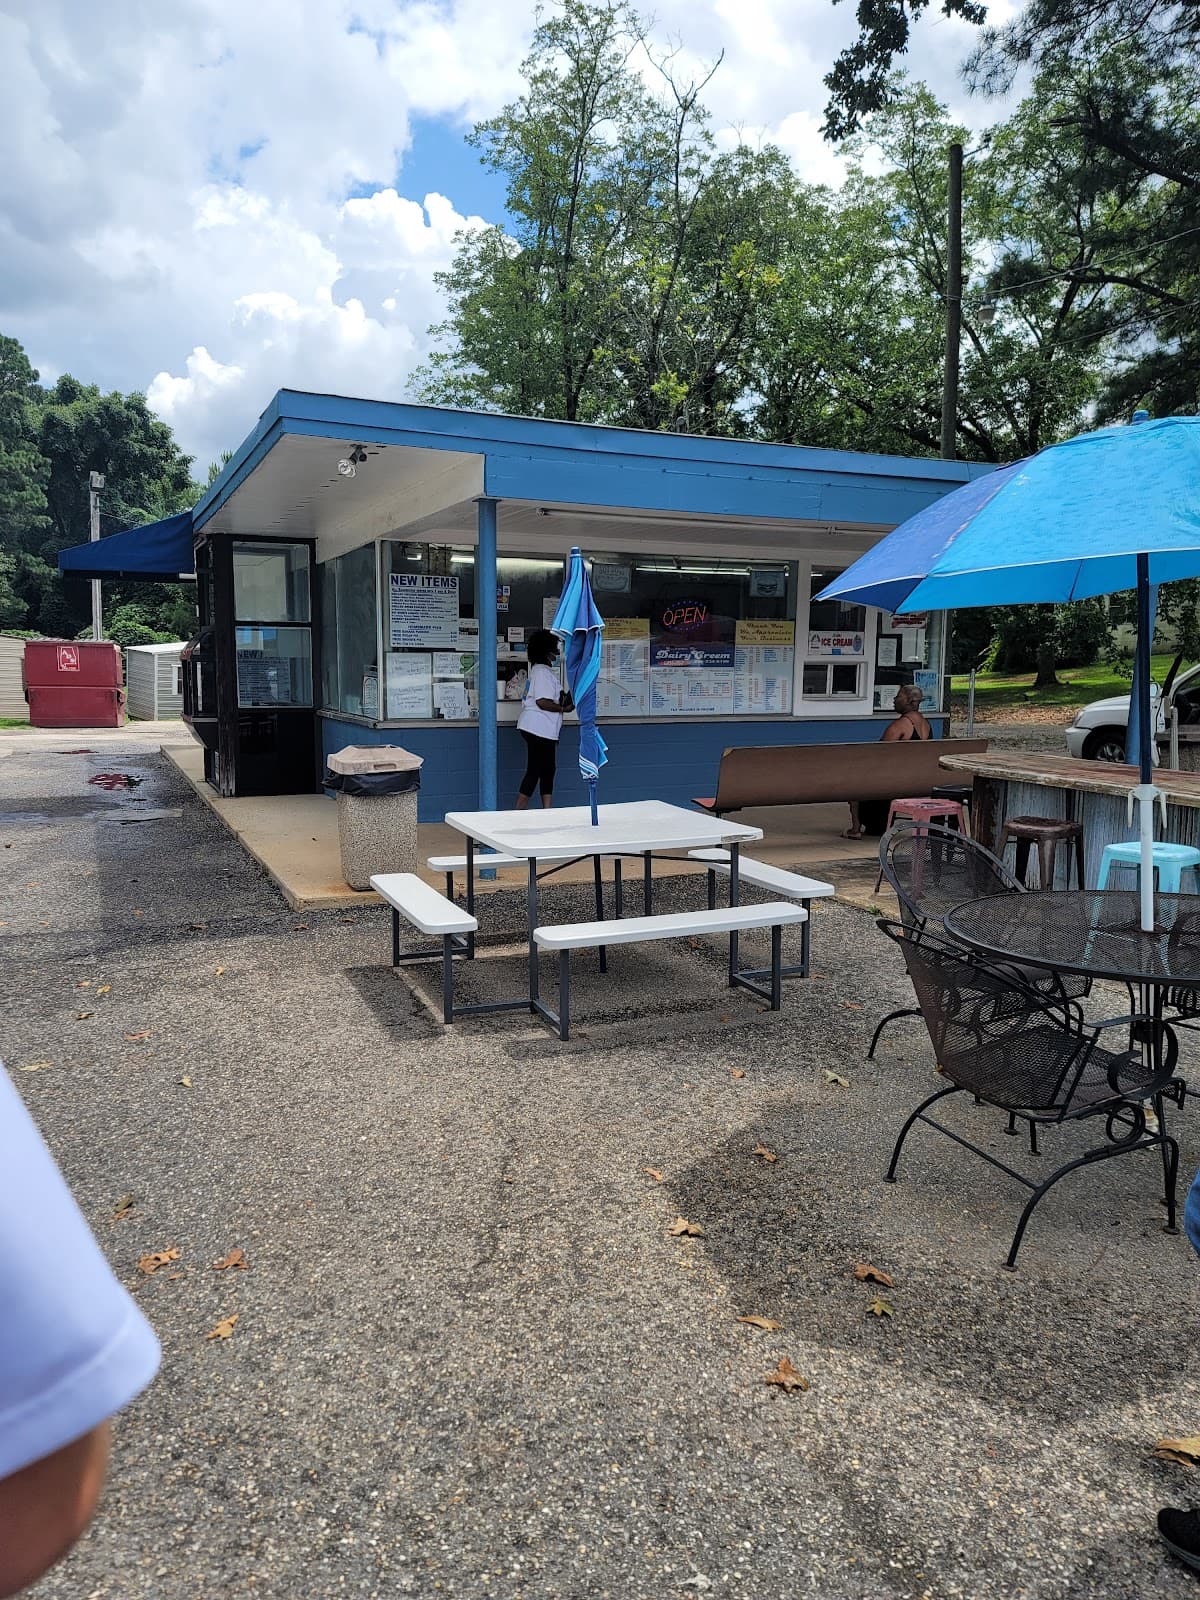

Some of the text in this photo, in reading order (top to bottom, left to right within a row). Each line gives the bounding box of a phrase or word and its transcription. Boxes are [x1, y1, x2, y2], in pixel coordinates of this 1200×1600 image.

[391, 575, 457, 588] NEW ITEMS
[663, 606, 706, 626] OPEN
[821, 638, 853, 647] ICE CREAM
[655, 649, 691, 661] Dairy
